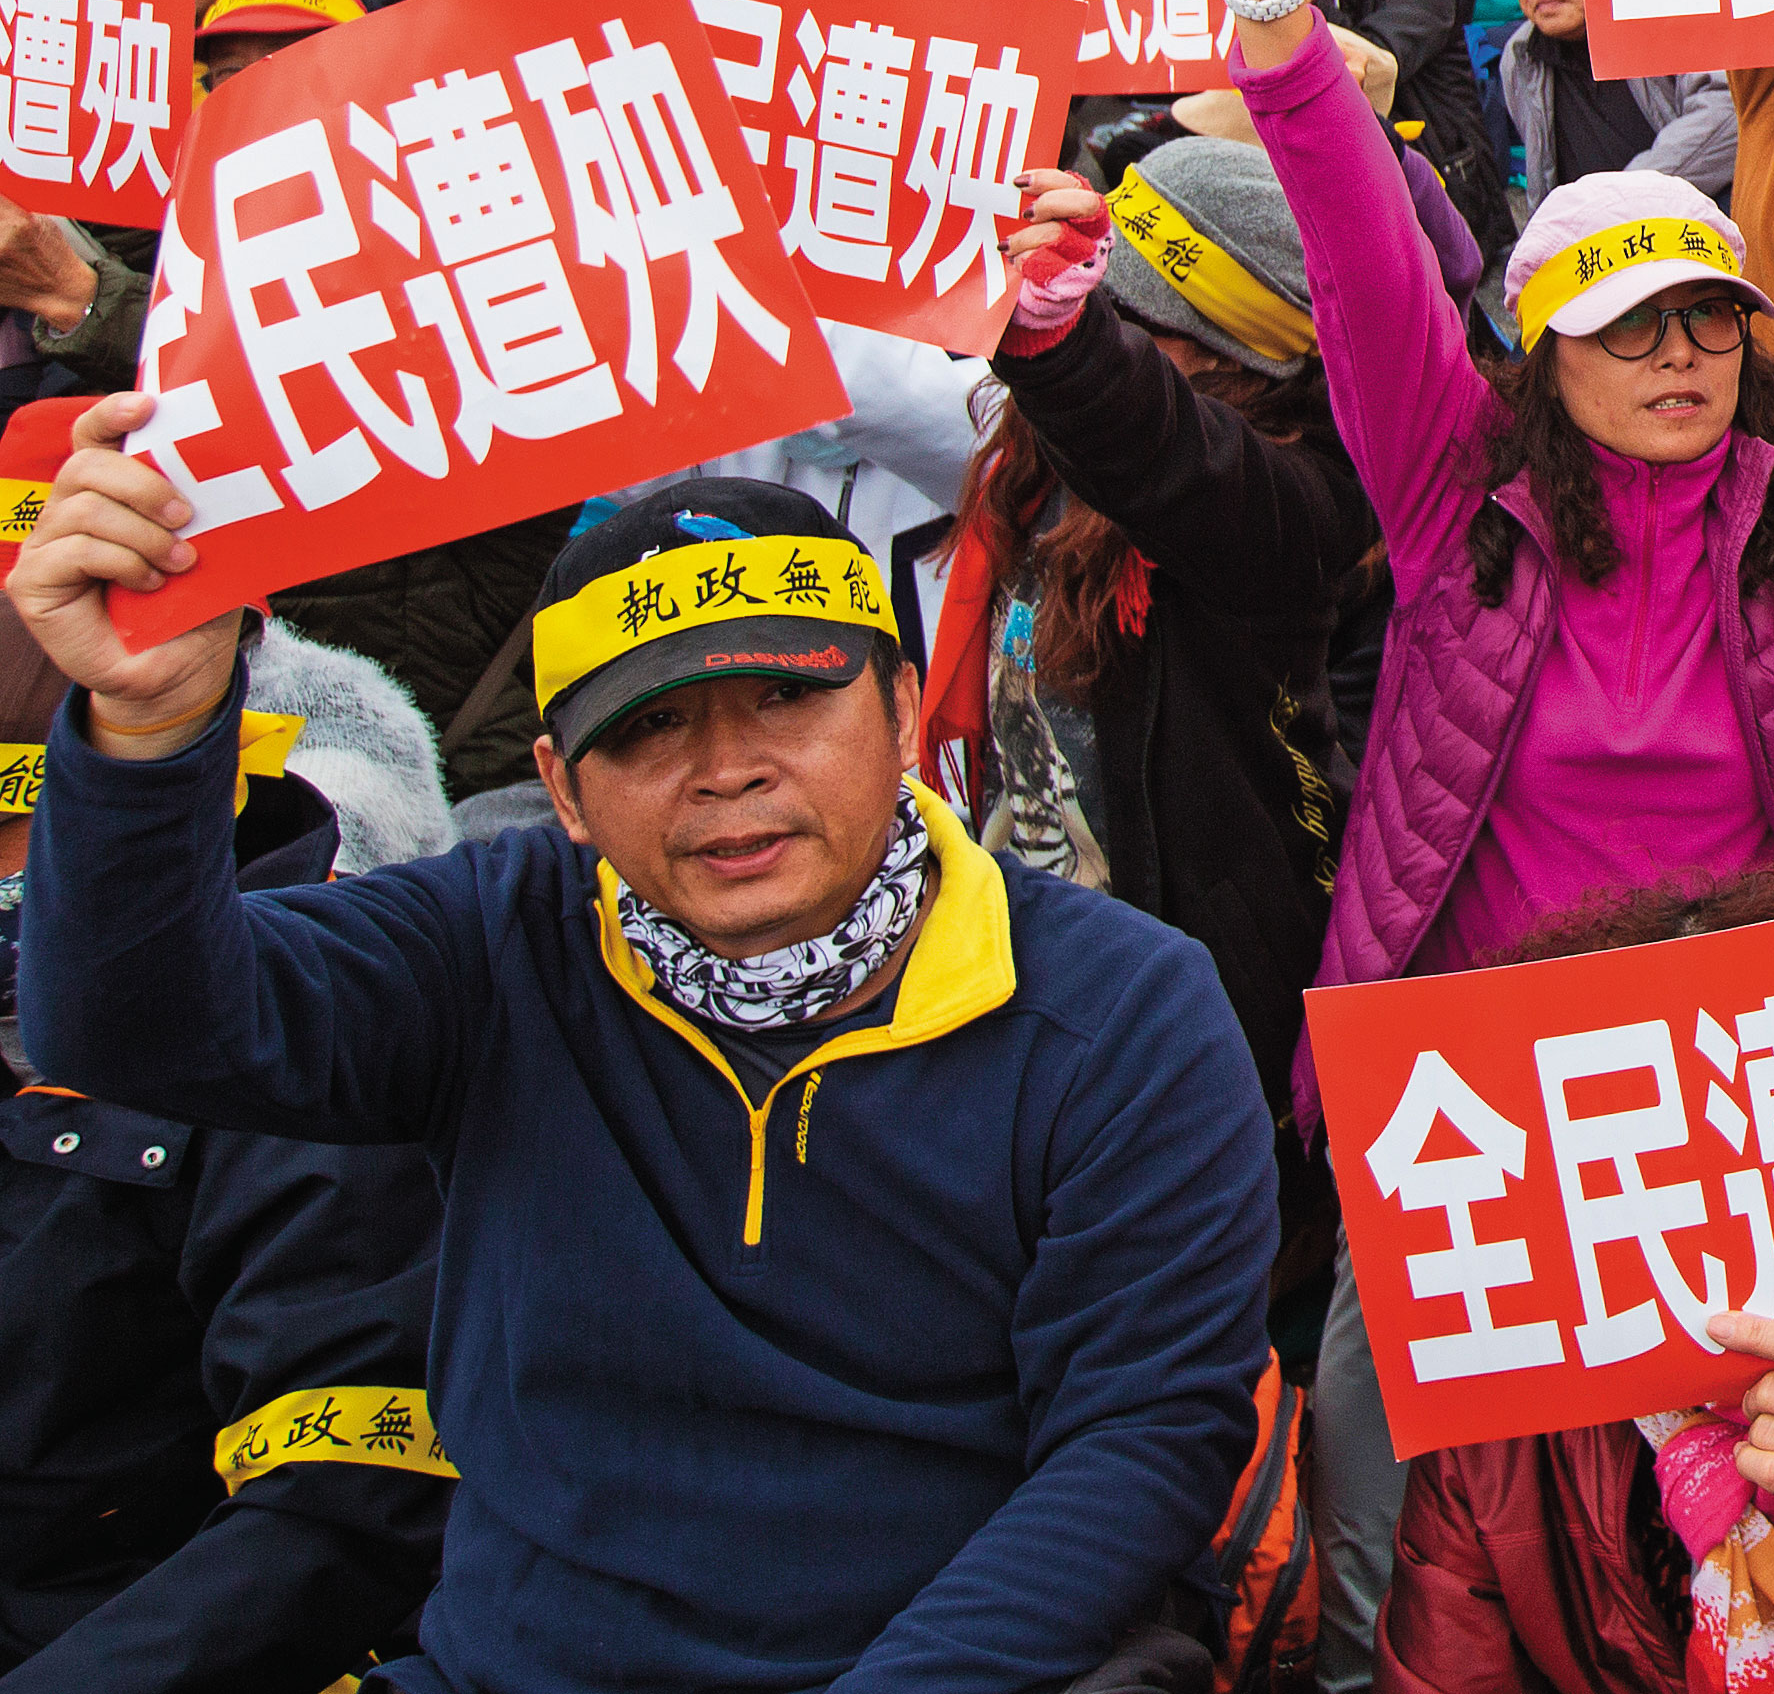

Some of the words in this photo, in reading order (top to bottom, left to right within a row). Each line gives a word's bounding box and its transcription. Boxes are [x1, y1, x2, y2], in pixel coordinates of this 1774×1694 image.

[124, 18, 791, 539] 全民遭殃
[617, 548, 880, 637] 執政無能
